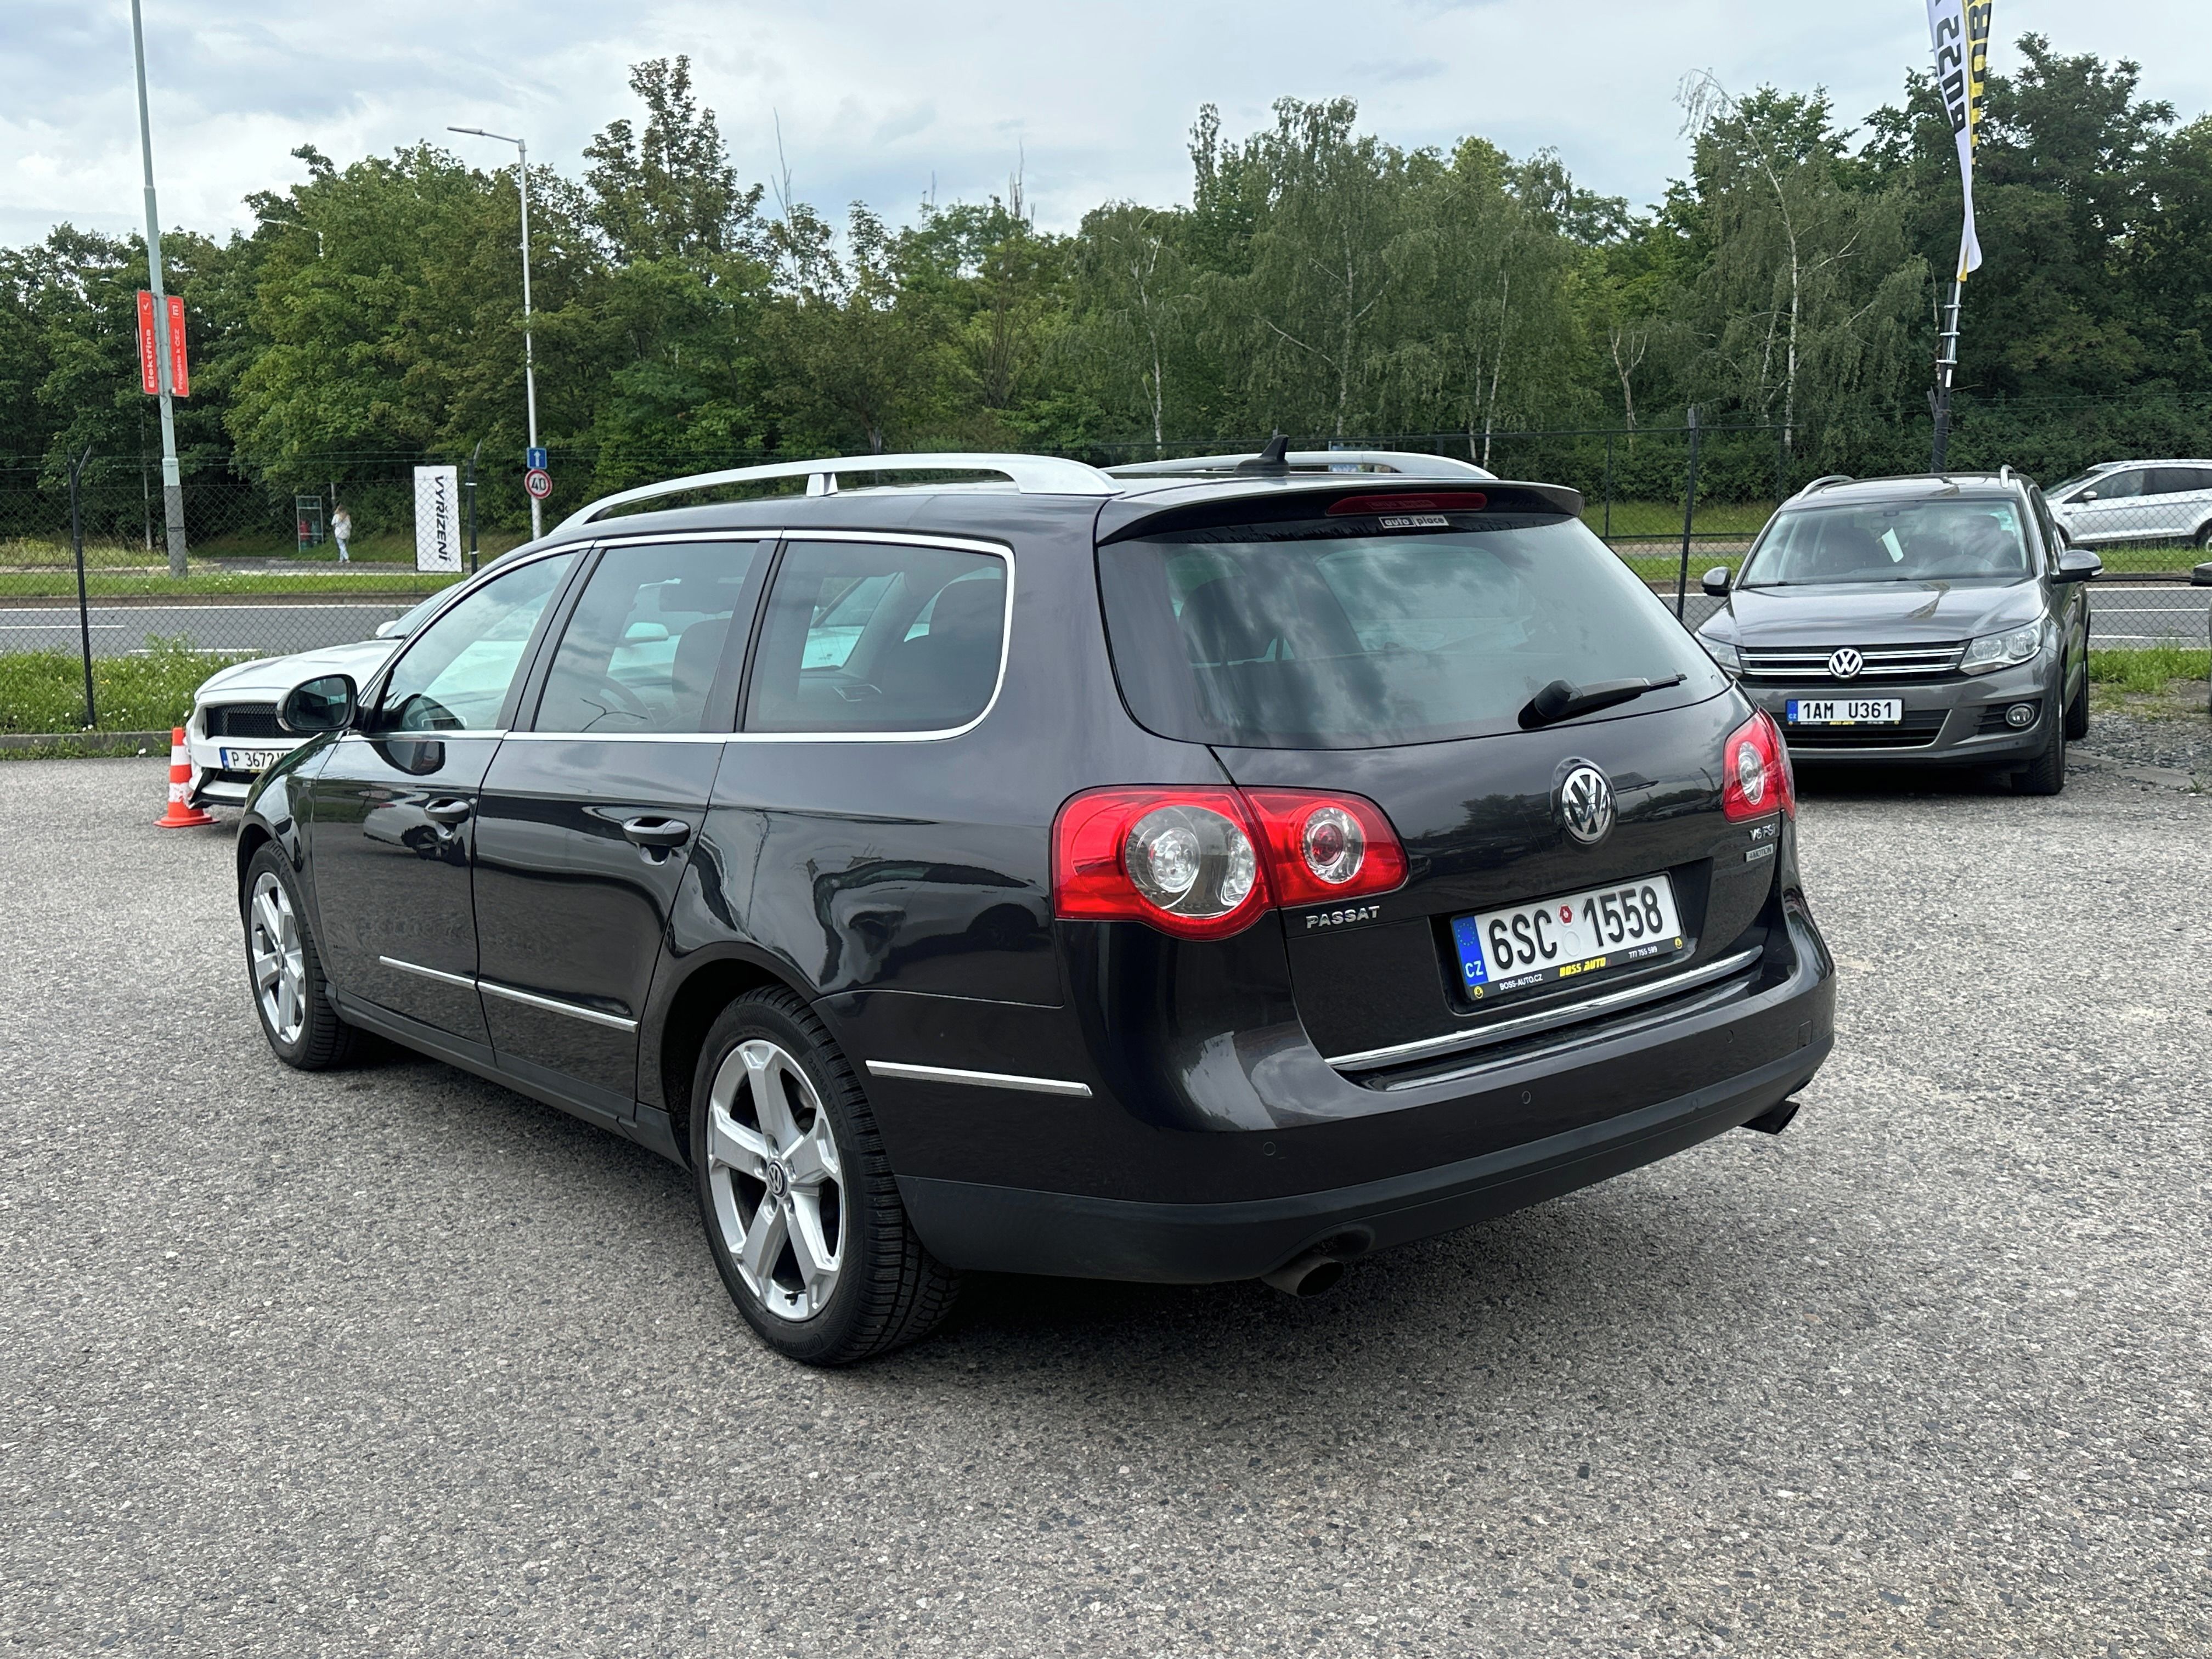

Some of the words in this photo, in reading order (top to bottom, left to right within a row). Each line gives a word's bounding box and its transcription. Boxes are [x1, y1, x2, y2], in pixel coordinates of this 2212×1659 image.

[145, 329, 155, 388] Elektřina
[531, 478, 546, 491] 40
[435, 475, 452, 562] VYŘÍZENÍ
[1385, 517, 1409, 526] auto
[1416, 516, 1445, 526] place
[1803, 703, 1833, 719] 1AM
[1848, 702, 1892, 719] U361
[232, 752, 239, 766] P
[1306, 905, 1380, 929] PASSAT
[1488, 909, 1558, 969] 6SC
[1581, 885, 1663, 947] 1558
[1465, 961, 1483, 978] CZ
[1559, 963, 1582, 977] BOSS
[1583, 957, 1606, 972] AUTO
[1499, 973, 1543, 990] BOSS-AUTO.CZ
